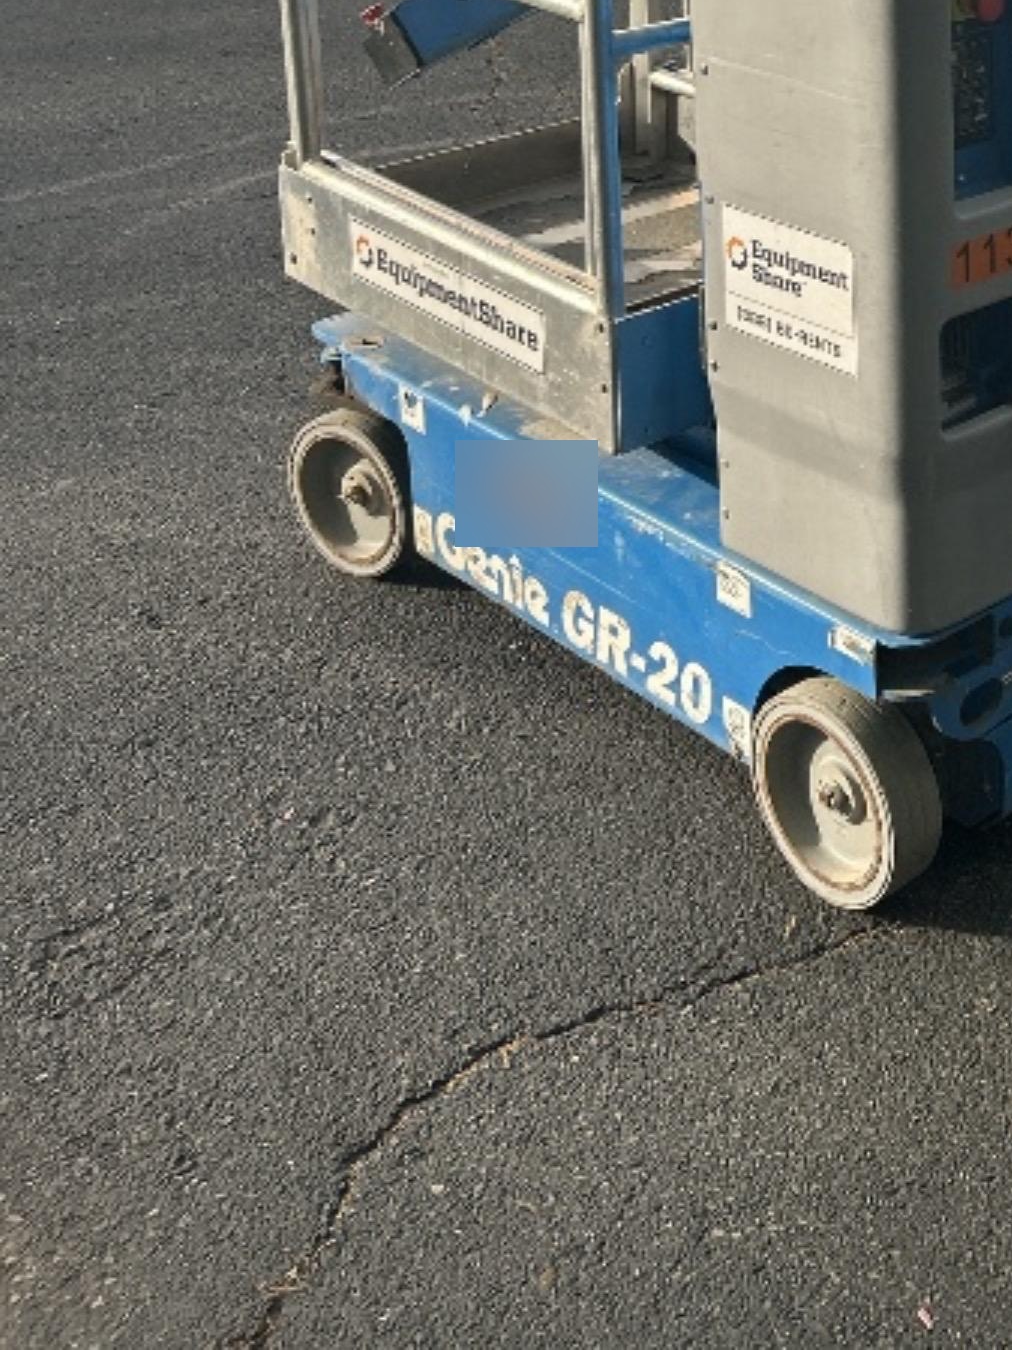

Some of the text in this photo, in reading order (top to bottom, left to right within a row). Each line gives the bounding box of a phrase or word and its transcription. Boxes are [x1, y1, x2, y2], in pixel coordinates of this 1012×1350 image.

[376, 247, 539, 352] EquipmentShare
[751, 238, 849, 291] Equipment
[562, 589, 712, 724] GR-20
